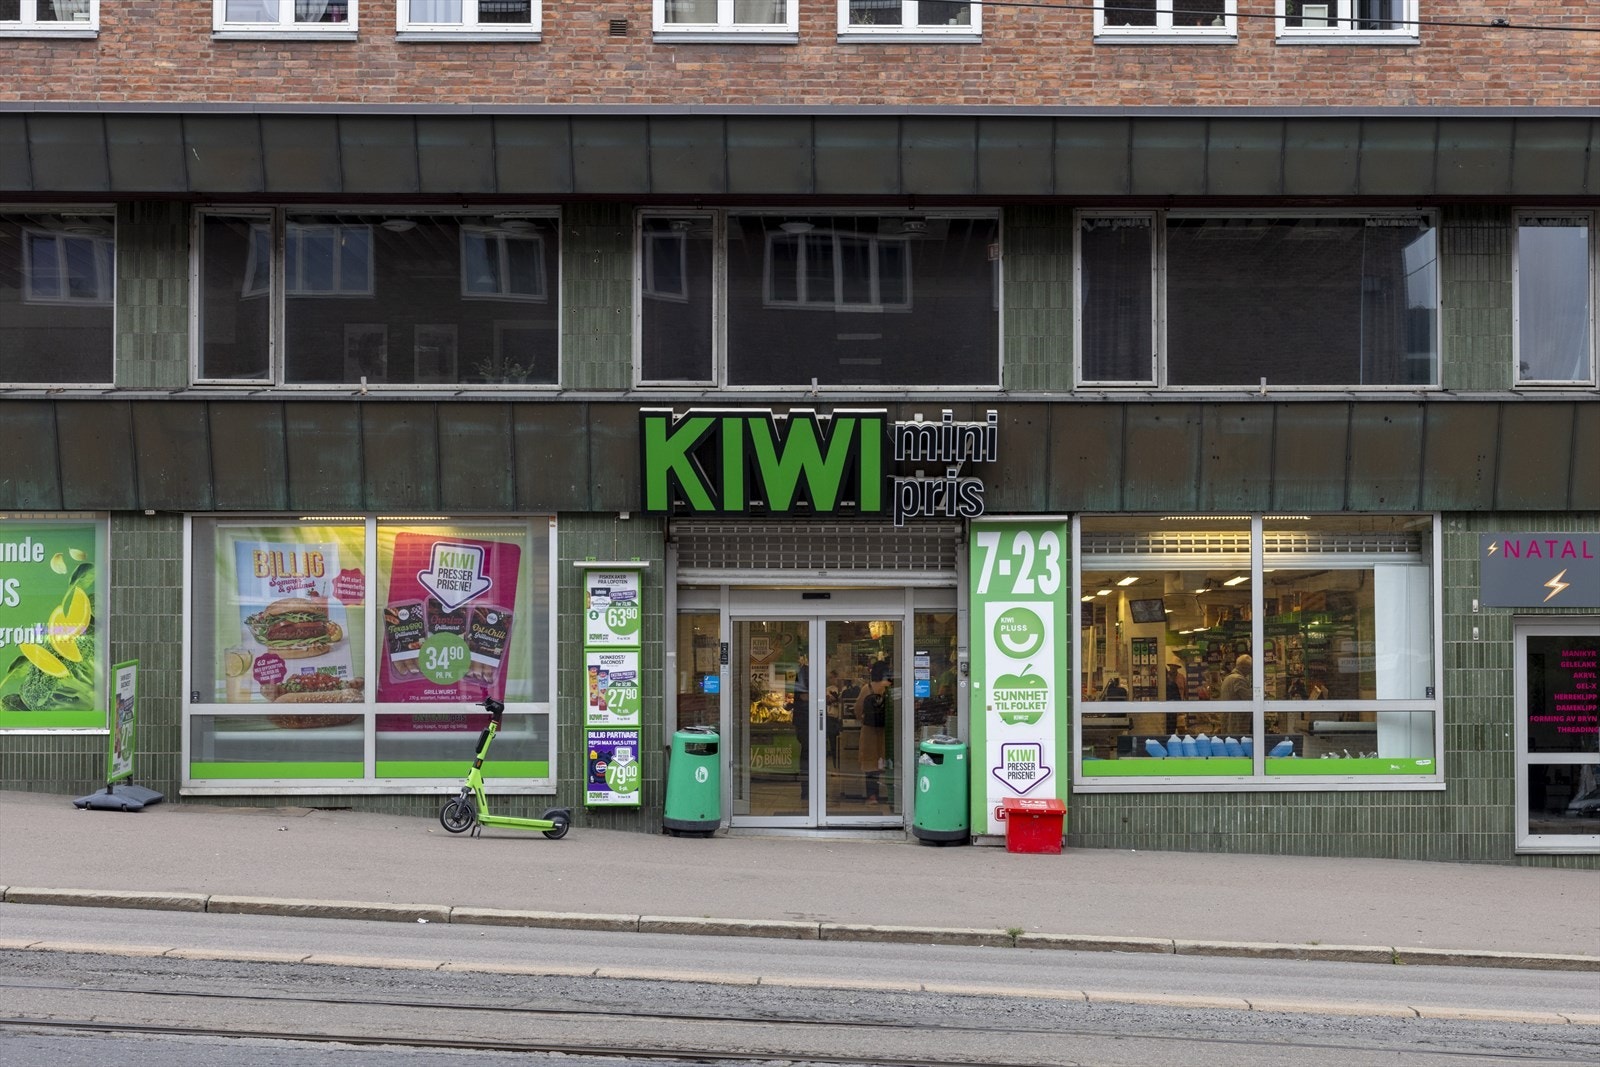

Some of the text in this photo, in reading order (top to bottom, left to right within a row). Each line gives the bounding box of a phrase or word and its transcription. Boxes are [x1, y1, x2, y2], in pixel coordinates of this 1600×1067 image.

[895, 410, 998, 462] mini
[641, 410, 885, 515] KIWI
[894, 469, 985, 526] pris
[0, 536, 44, 562] nde
[1504, 540, 1594, 559] NATAL
[253, 549, 325, 578] BILLIG
[439, 551, 475, 570] KIWI
[976, 530, 1061, 595] 7-23
[438, 568, 473, 581] PRESSER
[0, 578, 20, 607] S
[437, 579, 472, 592] PRISENE!
[993, 690, 1049, 701] SUNNHET
[995, 702, 1047, 710] TIL FOLKET
[764, 754, 793, 765] BONUS
[1007, 749, 1036, 762] KIWI
[1007, 762, 1036, 771] PRESSER
[1007, 771, 1036, 780] PRISENE!
